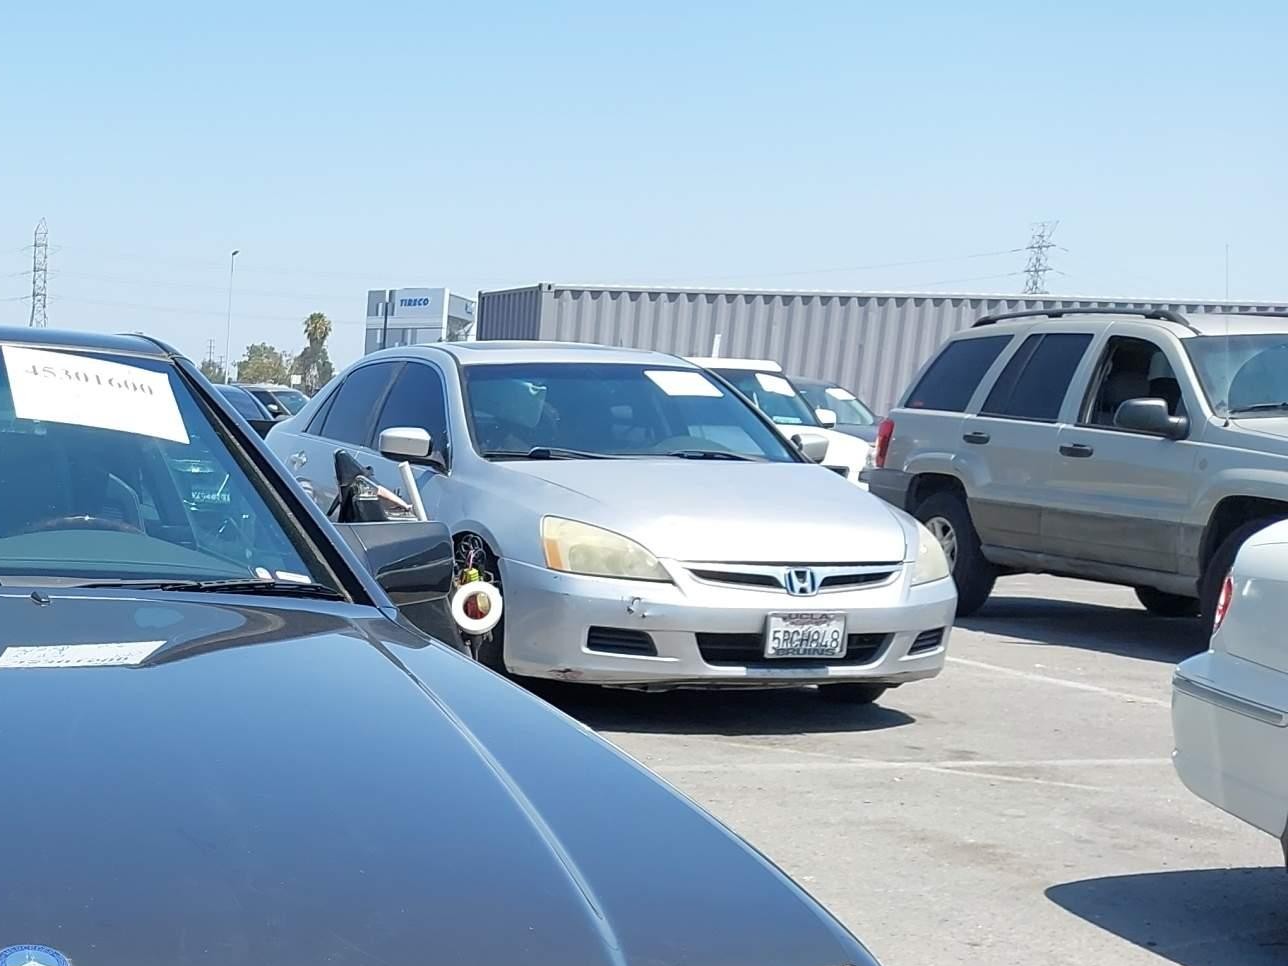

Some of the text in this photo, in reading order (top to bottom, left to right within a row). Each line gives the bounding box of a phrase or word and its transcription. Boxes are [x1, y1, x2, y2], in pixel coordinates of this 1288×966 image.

[787, 612, 830, 620] UCLA
[772, 630, 840, 648] 5RCH848
[776, 648, 836, 656] BRUINS
